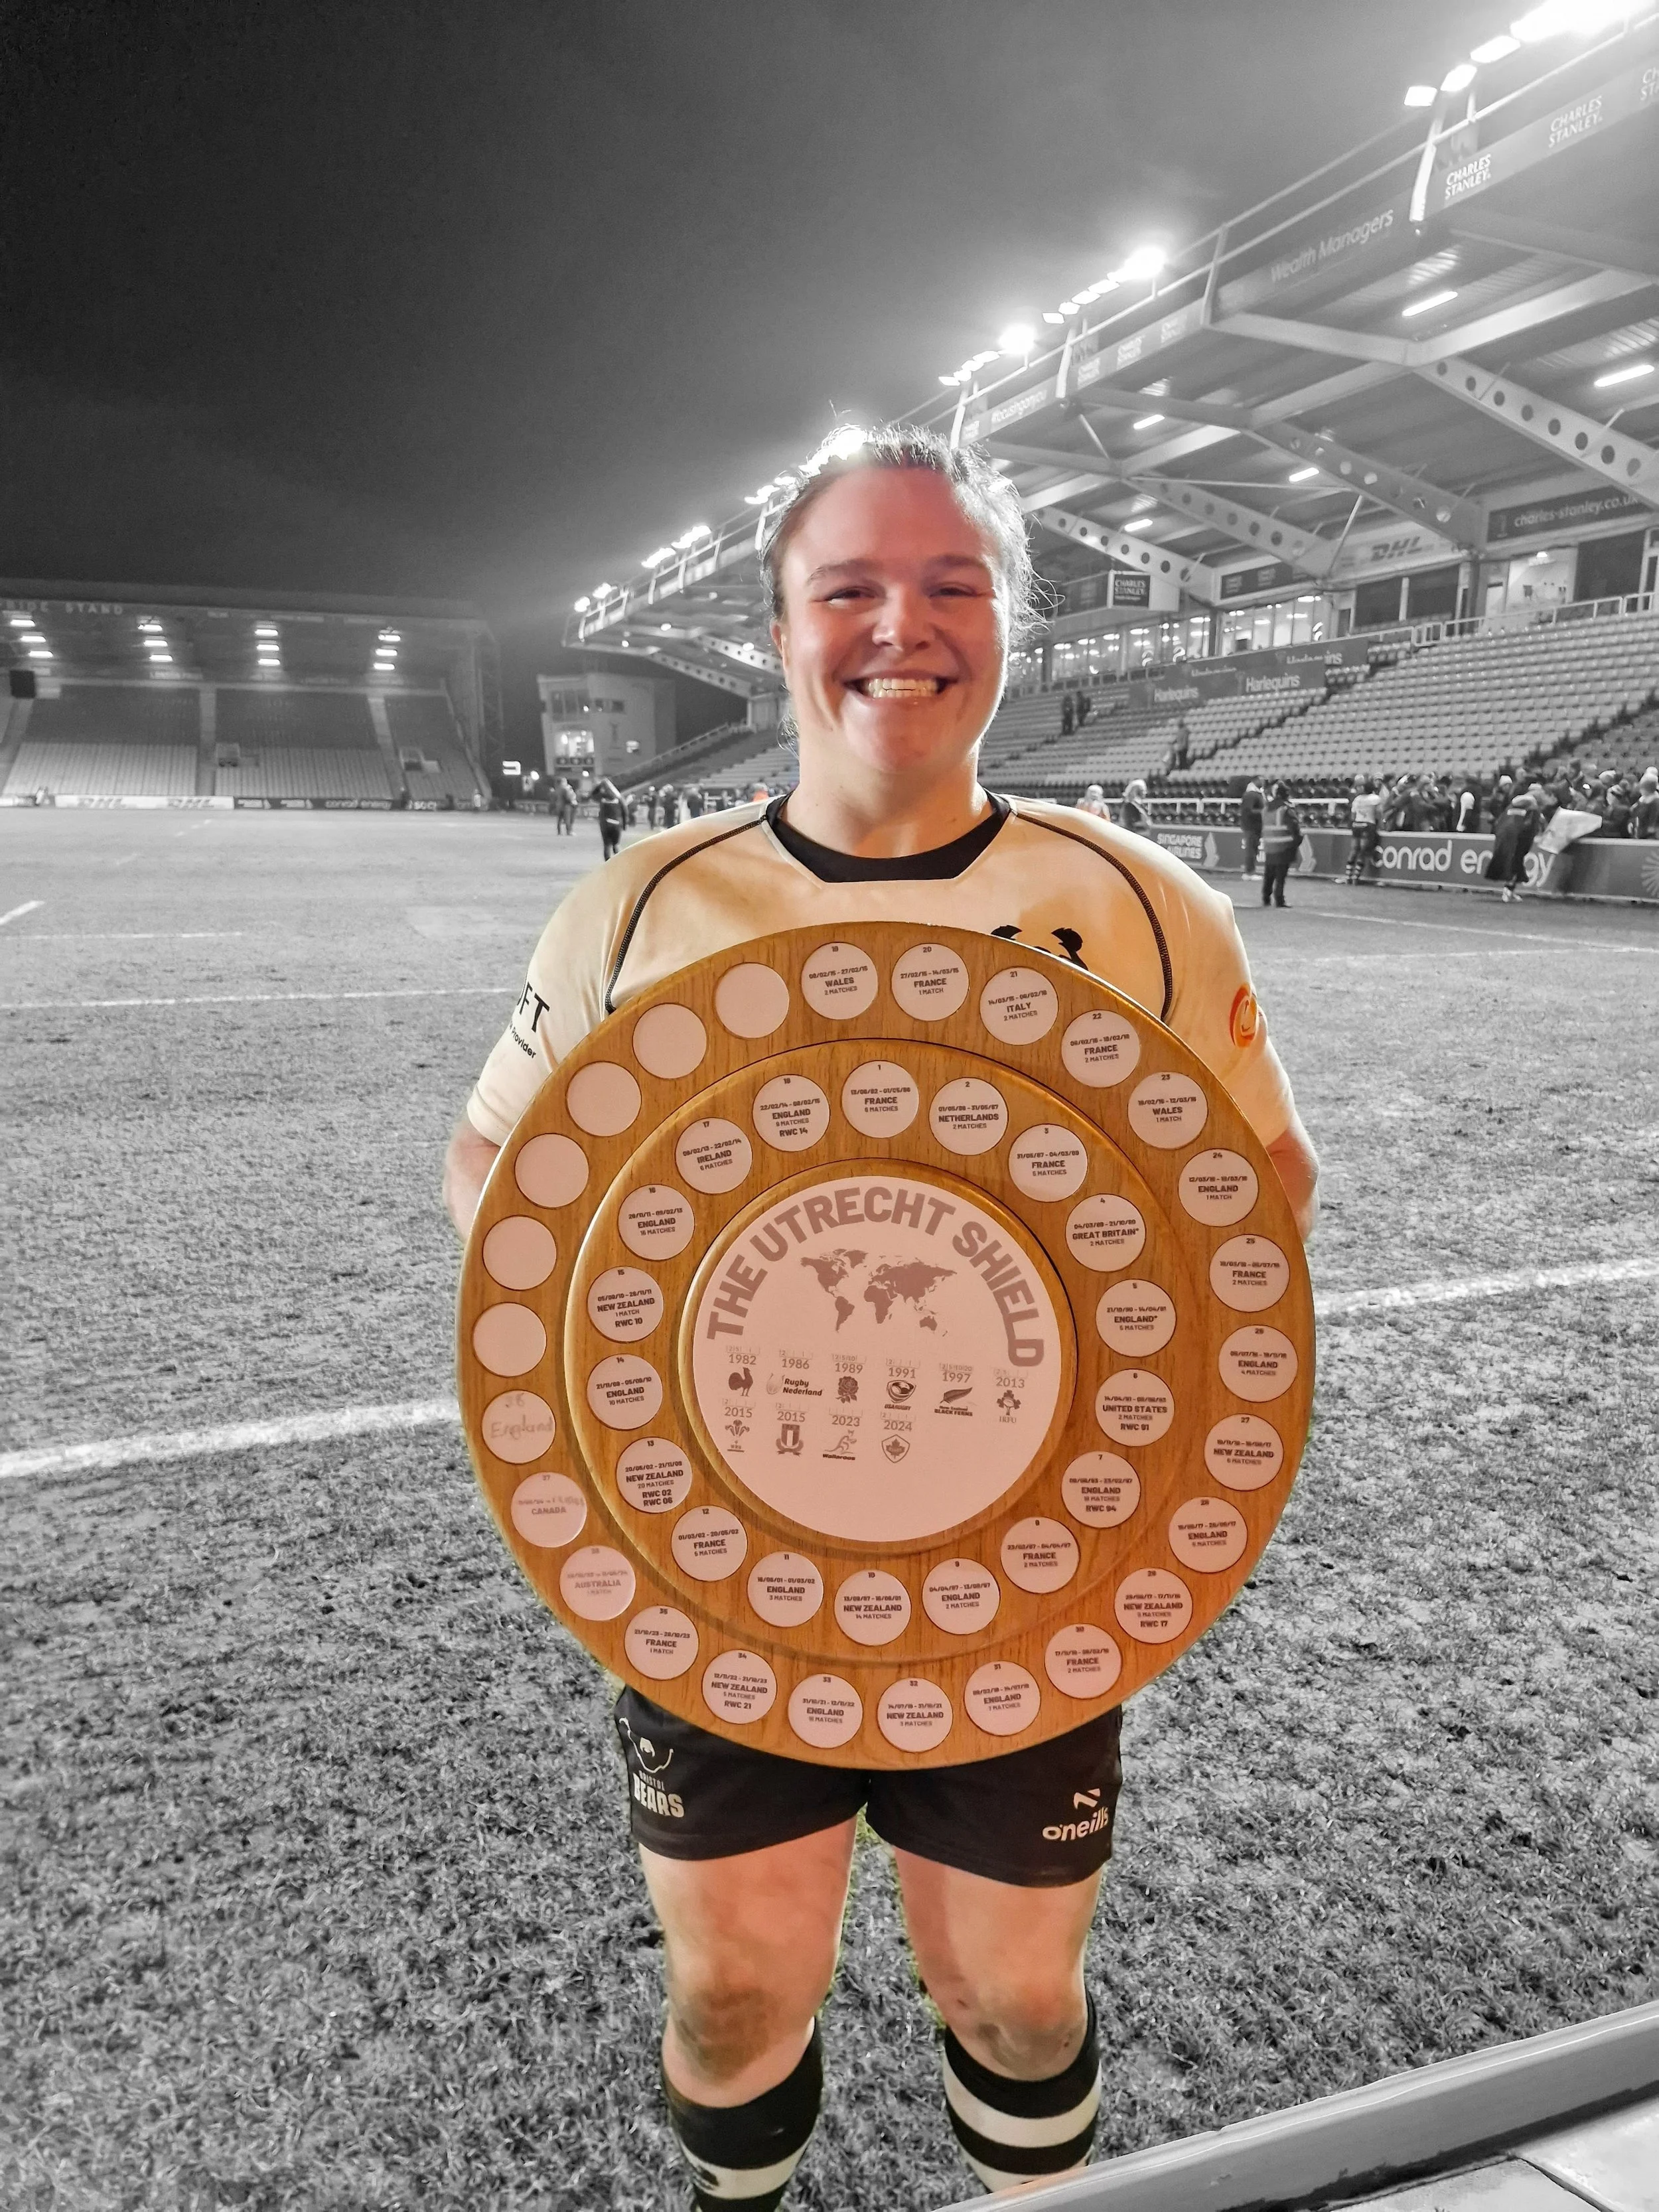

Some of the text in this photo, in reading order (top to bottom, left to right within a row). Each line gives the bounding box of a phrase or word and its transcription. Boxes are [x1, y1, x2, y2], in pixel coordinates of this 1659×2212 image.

[1550, 94, 1603, 132] CHARLES
[1446, 153, 1491, 186] CHARLES
[1318, 209, 1394, 260] Managers
[1370, 536, 1424, 561] DHL
[1371, 839, 1453, 872] conrad
[825, 977, 854, 988] WALES
[914, 978, 947, 988] FRANCE
[1007, 1002, 1031, 1013] ITALY
[1084, 1044, 1118, 1055] FRANCE
[865, 1096, 898, 1105] FRANCE
[772, 1108, 811, 1120] ENGLAND
[1152, 1106, 1183, 1116] WALES
[938, 1113, 999, 1122] NETHERLANDS
[779, 1128, 798, 1137] RWC
[697, 1149, 732, 1163] IRELAND
[705, 1159, 733, 1169] MATCHES
[1032, 1160, 1066, 1169] FRANCE
[637, 1217, 676, 1228] ENGLAND
[1072, 1231, 1100, 1240] GREAT
[707, 1186, 1045, 1367] THE UTRECHT SHIELD
[597, 1297, 655, 1312] NEW ZEALAND
[615, 1319, 633, 1327] RWC
[729, 1353, 757, 1365] 1982
[782, 1358, 810, 1369] 1986
[1238, 1360, 1278, 1368] ENGLAND
[835, 1362, 863, 1374] 1989
[888, 1367, 916, 1379] 1991
[784, 1378, 809, 1387] Rugby
[942, 1372, 971, 1383] 1997
[996, 1376, 1025, 1388] 2013
[606, 1386, 644, 1398] ENGLAND
[782, 1387, 823, 1396] Nederland
[616, 1396, 644, 1404] MATCHES
[724, 1406, 753, 1418] 2015
[776, 1411, 806, 1423] 2015
[831, 1415, 861, 1427] 2023
[883, 1420, 912, 1432] 2024
[490, 1415, 554, 1440] England
[1234, 1449, 1274, 1458] ZEALAND
[626, 1469, 684, 1483] NEW ZEALAND
[642, 1490, 660, 1499] RWC
[643, 1498, 662, 1507] RWC
[532, 1506, 567, 1515] CANADA
[1188, 1530, 1228, 1540] ENGLAND
[693, 1539, 726, 1549] FRANCE
[1023, 1552, 1056, 1560] FRANCE
[574, 1580, 621, 1589] AUSTRALIA
[766, 1585, 805, 1594] ENGLAND
[942, 1592, 980, 1602] ENGLAND
[646, 1639, 677, 1648] FRANCE
[1066, 1657, 1099, 1666] FRANCE
[730, 1684, 768, 1694] ZEALAND
[983, 1693, 1021, 1704] ENGLAND
[806, 1707, 844, 1716] ENGLAND
[632, 1772, 685, 1818] BEARS
